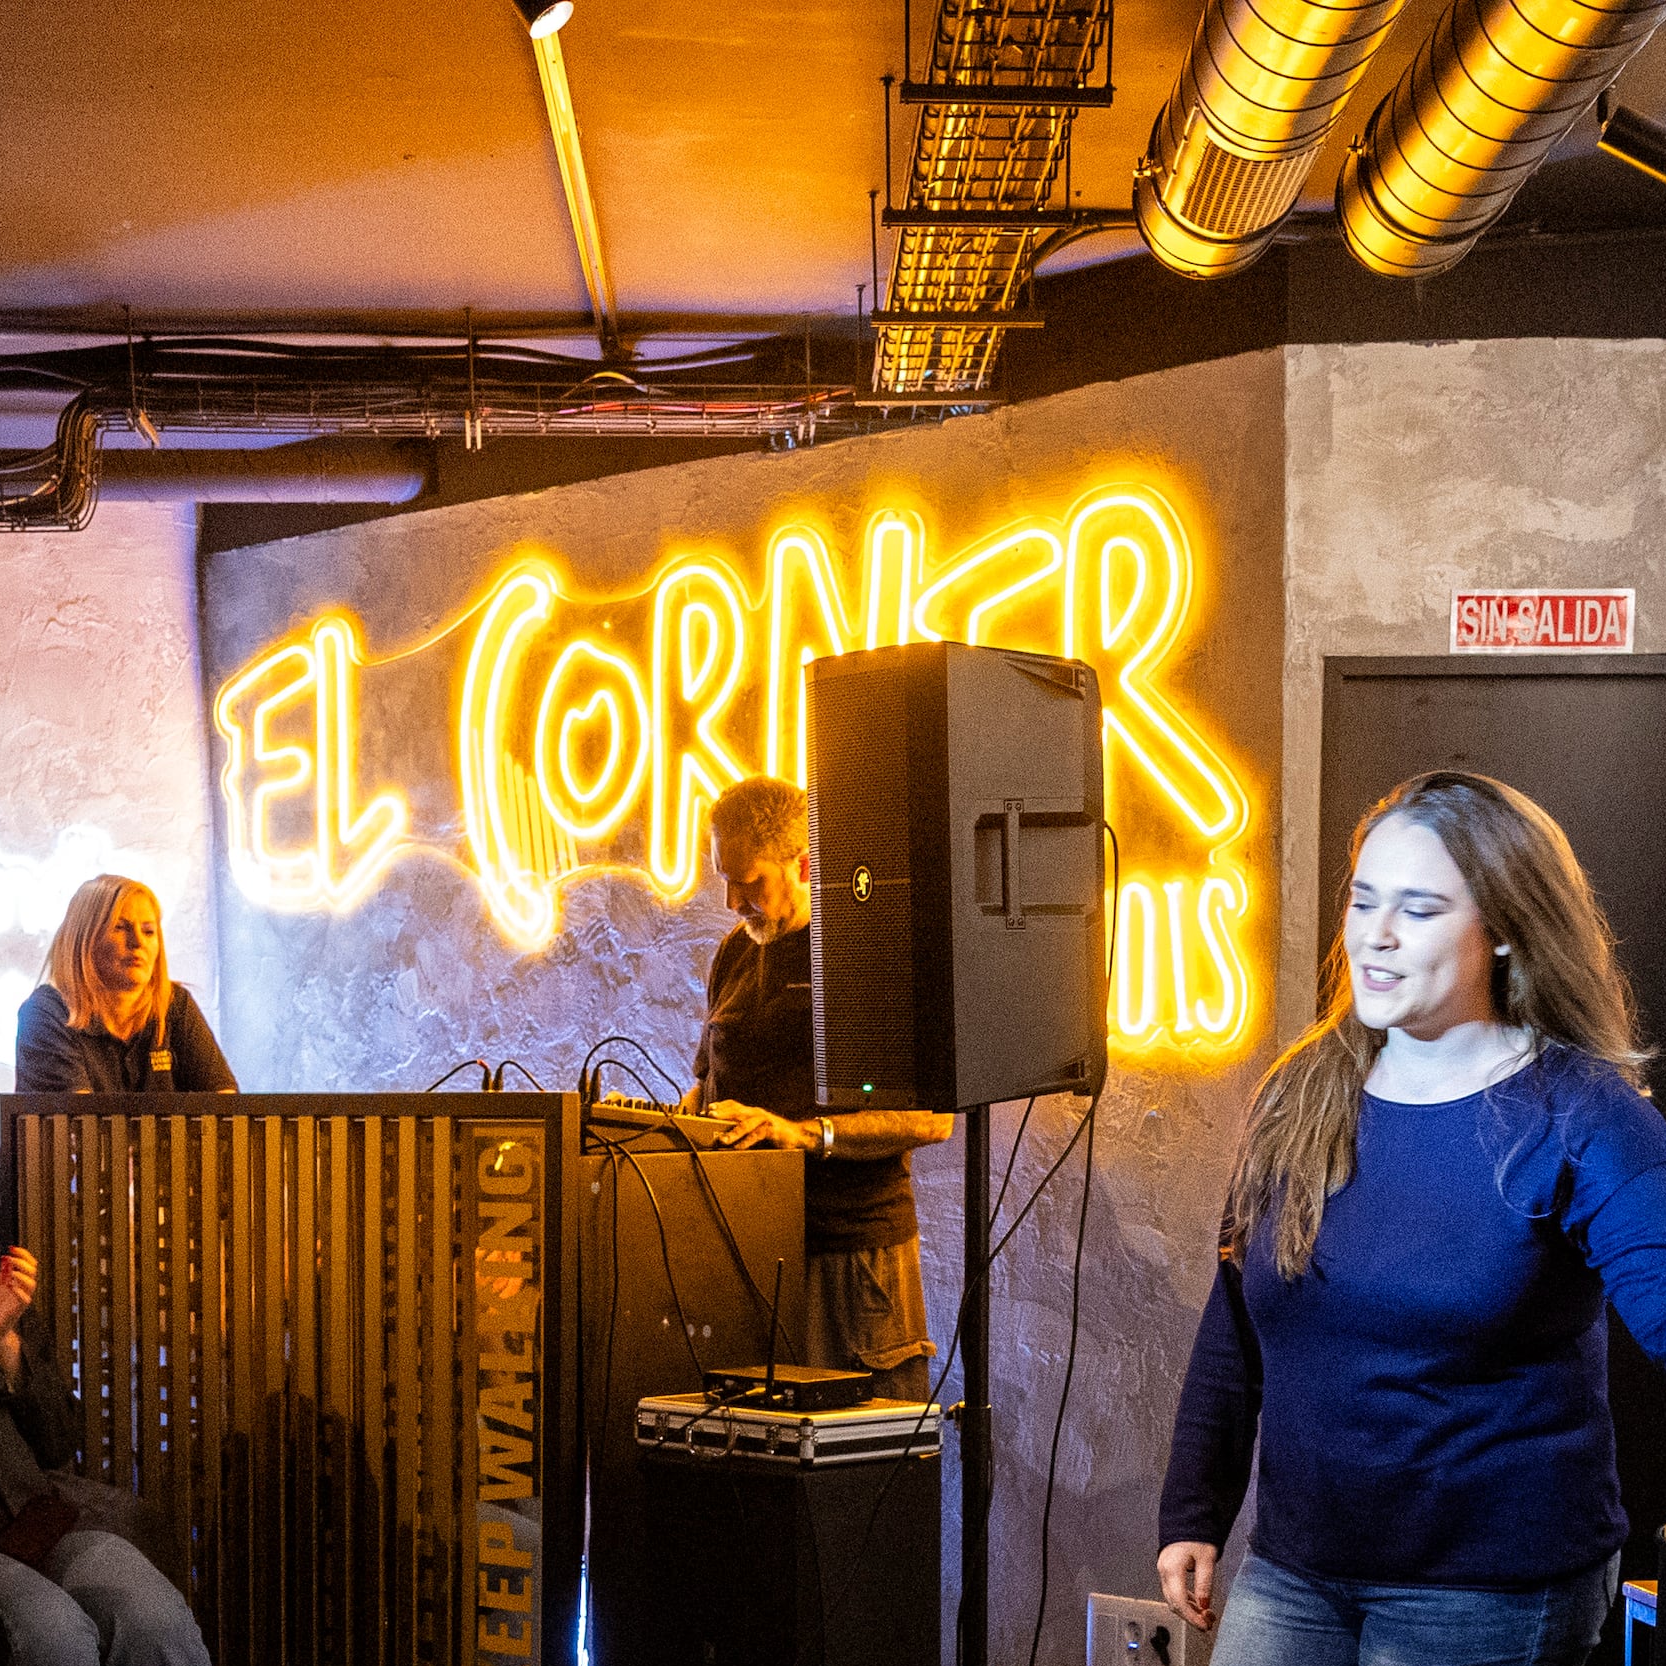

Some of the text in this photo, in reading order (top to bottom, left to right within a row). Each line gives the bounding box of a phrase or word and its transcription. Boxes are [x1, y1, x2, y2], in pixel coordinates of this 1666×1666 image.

[1460, 599, 1623, 643] SIN SALIDA
[217, 624, 406, 900] EL
[477, 1141, 534, 1500] WALKING
